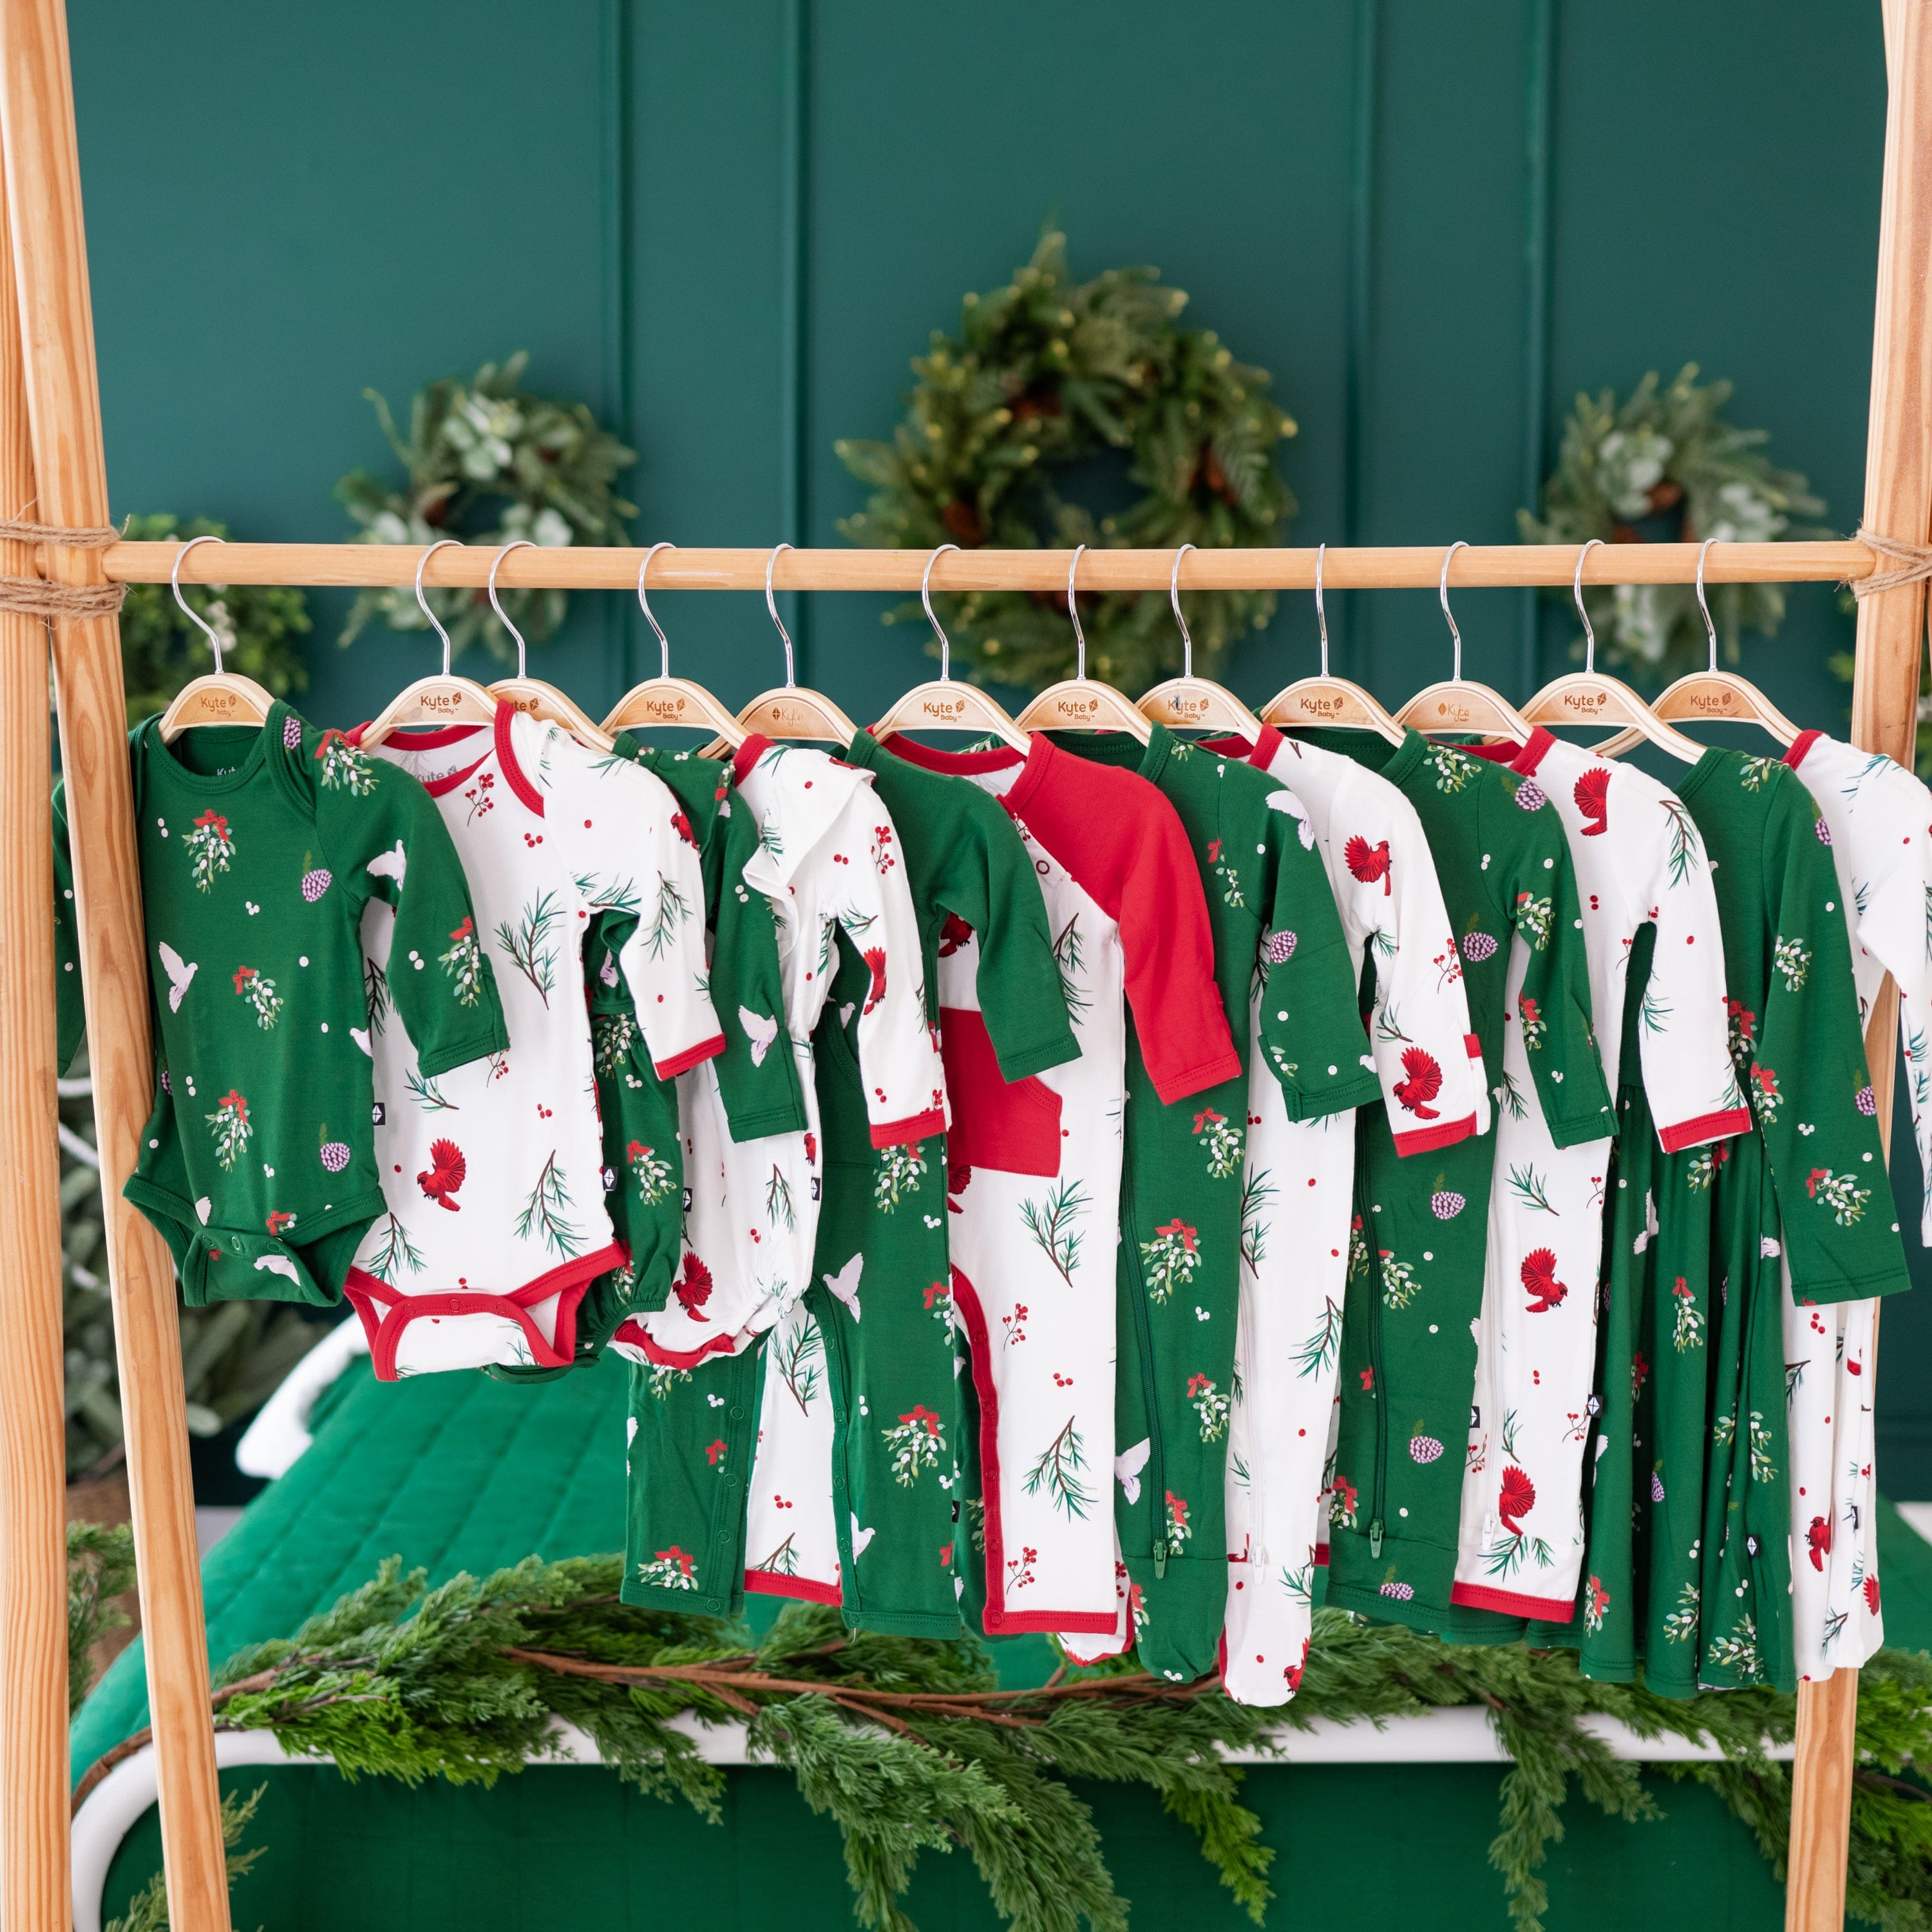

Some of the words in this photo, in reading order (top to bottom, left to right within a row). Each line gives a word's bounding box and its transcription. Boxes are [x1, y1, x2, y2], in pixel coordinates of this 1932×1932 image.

[200, 697, 226, 712] Kyte
[421, 696, 450, 710] Kyte
[647, 701, 674, 715] Kyte
[1058, 701, 1086, 716] Kyte
[1168, 700, 1197, 715] Kyte
[1301, 699, 1331, 713] Kyte
[1564, 695, 1594, 709] Kyte
[1690, 695, 1719, 710] Kyte
[923, 703, 952, 717] Kyte
[1448, 703, 1470, 722] Kyte
